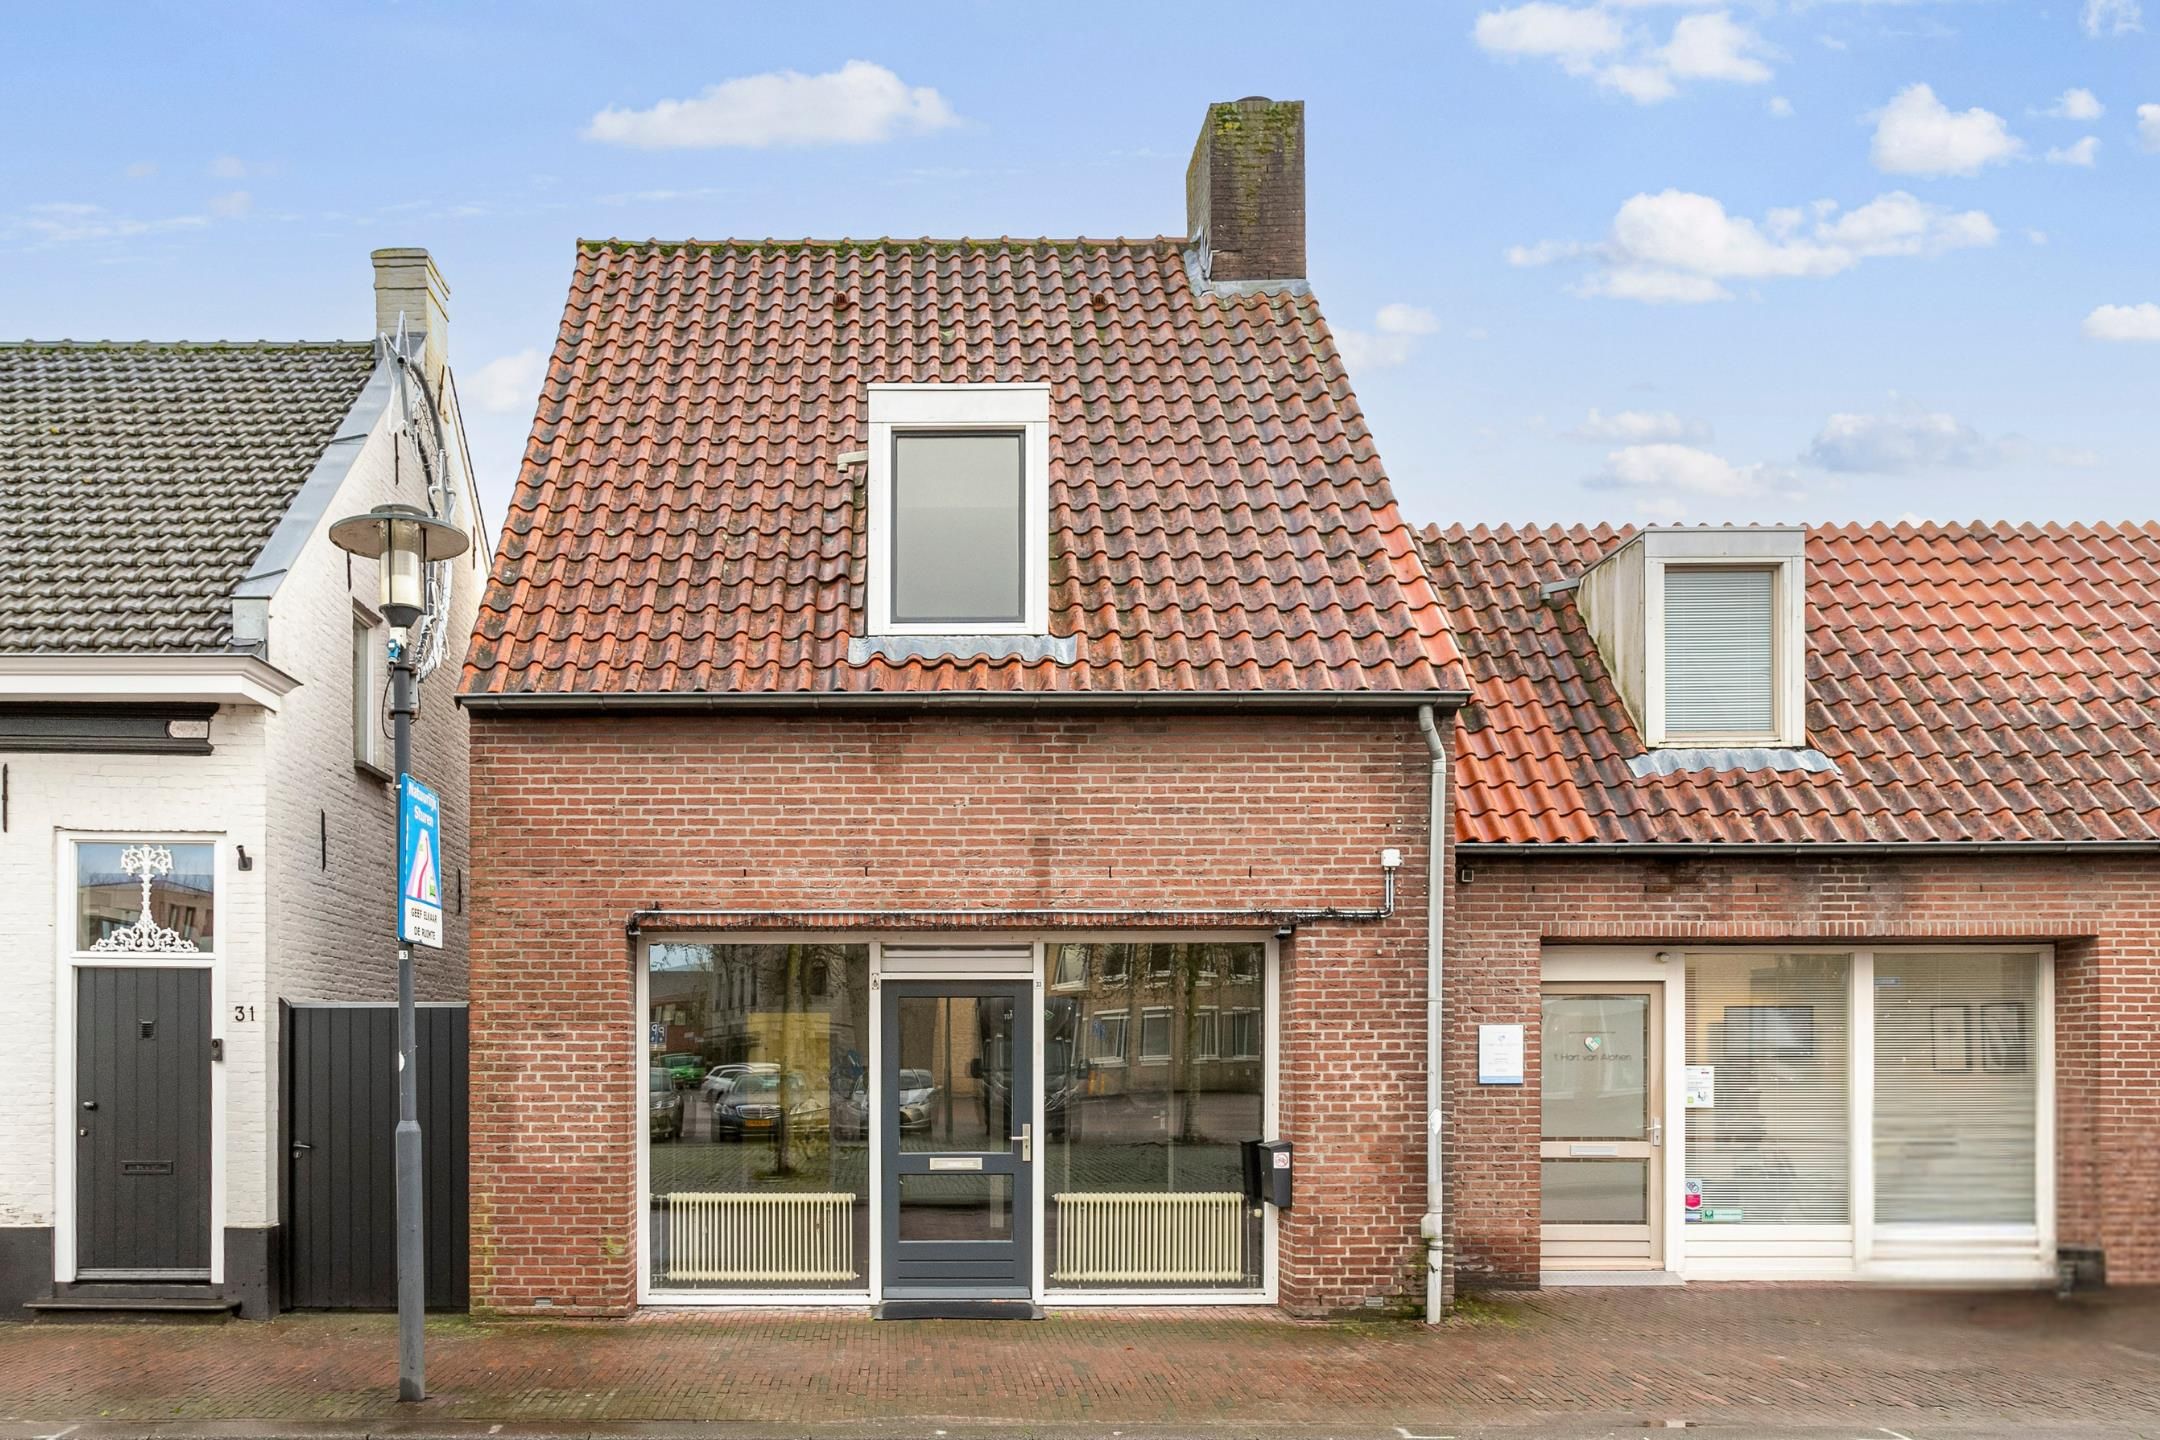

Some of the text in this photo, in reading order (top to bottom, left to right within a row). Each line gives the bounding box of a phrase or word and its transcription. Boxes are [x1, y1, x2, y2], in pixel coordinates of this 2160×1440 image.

[411, 907, 422, 919] GEEF
[414, 926, 421, 937] DE
[235, 1005, 254, 1022] 31
